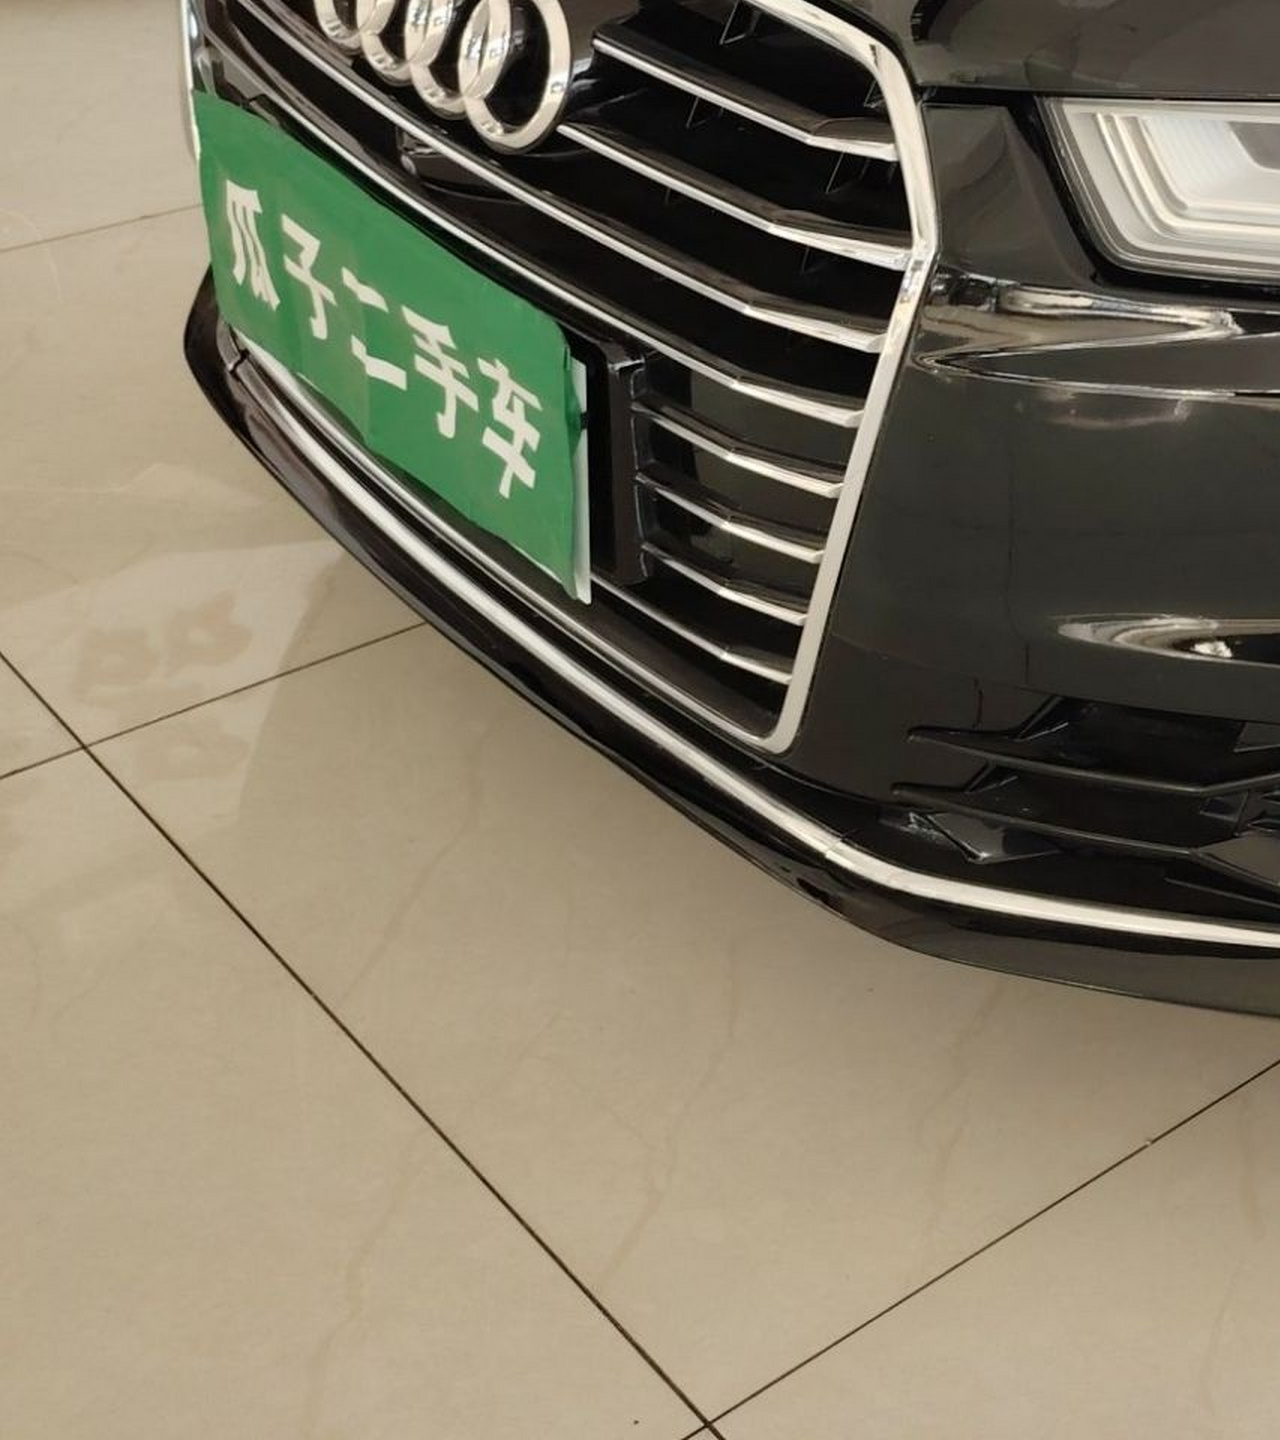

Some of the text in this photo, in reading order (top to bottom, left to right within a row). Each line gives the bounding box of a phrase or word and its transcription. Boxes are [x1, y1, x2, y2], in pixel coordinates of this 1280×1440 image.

[222, 178, 542, 500] 瓜子二手车
